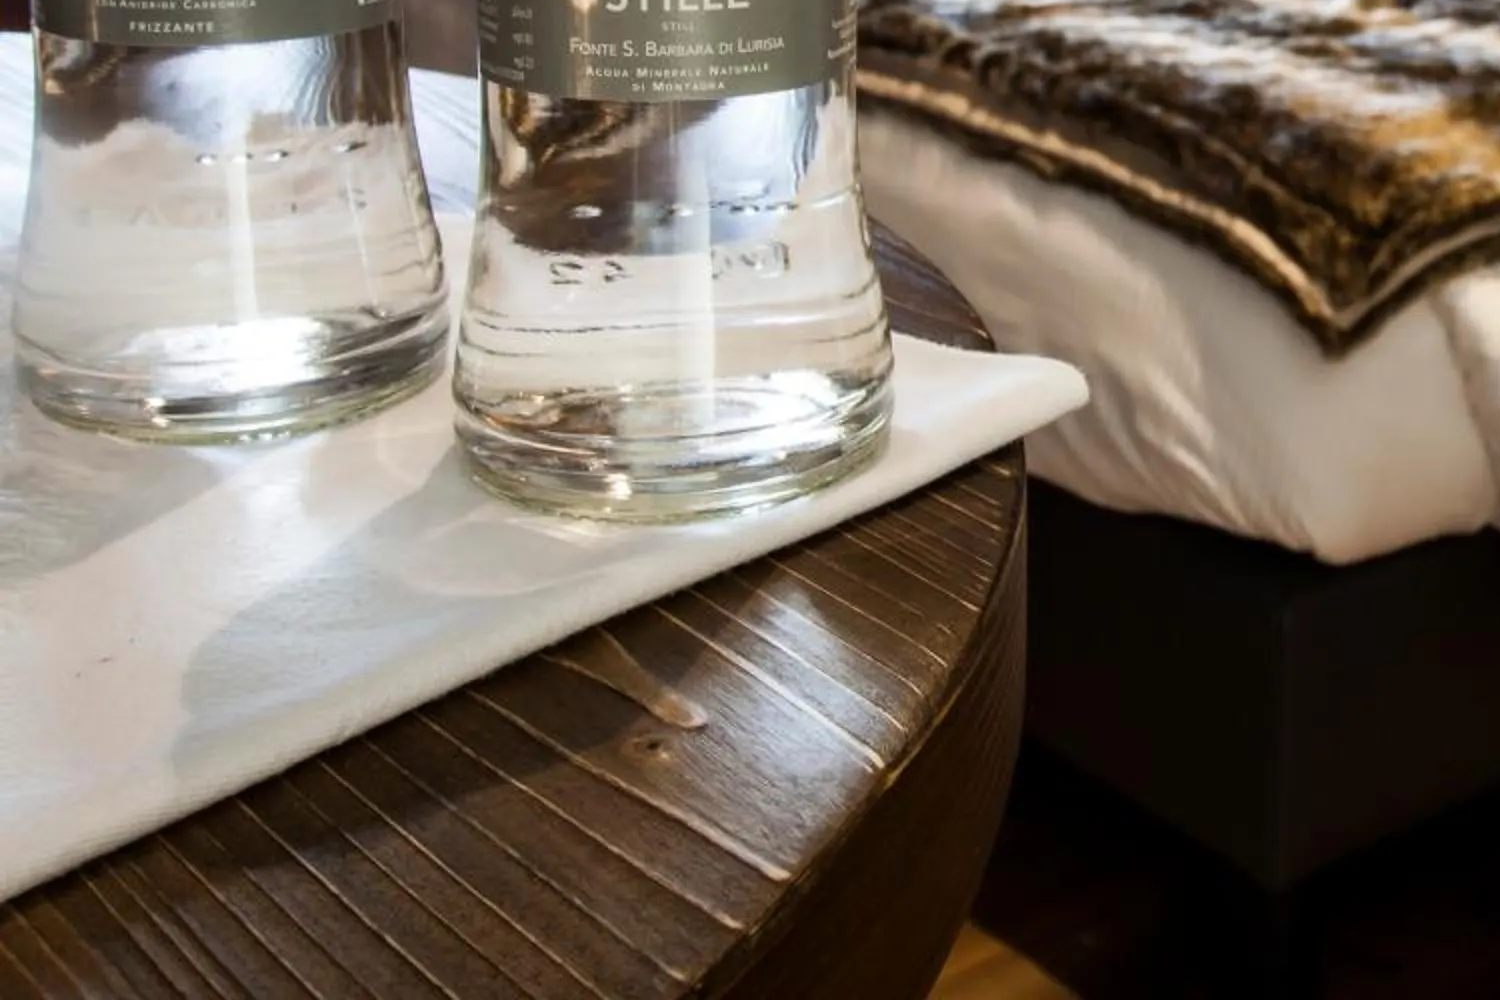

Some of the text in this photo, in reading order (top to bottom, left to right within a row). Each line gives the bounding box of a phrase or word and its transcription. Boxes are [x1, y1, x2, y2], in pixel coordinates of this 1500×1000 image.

[129, 21, 214, 33] FRIZZANTE
[661, 21, 695, 32] STILL
[569, 36, 785, 57] FONTE S. BARBARA DI LURISIA
[586, 62, 769, 79] ACQUA MINERALE NATURALE
[652, 81, 725, 92] MONTAGNA
